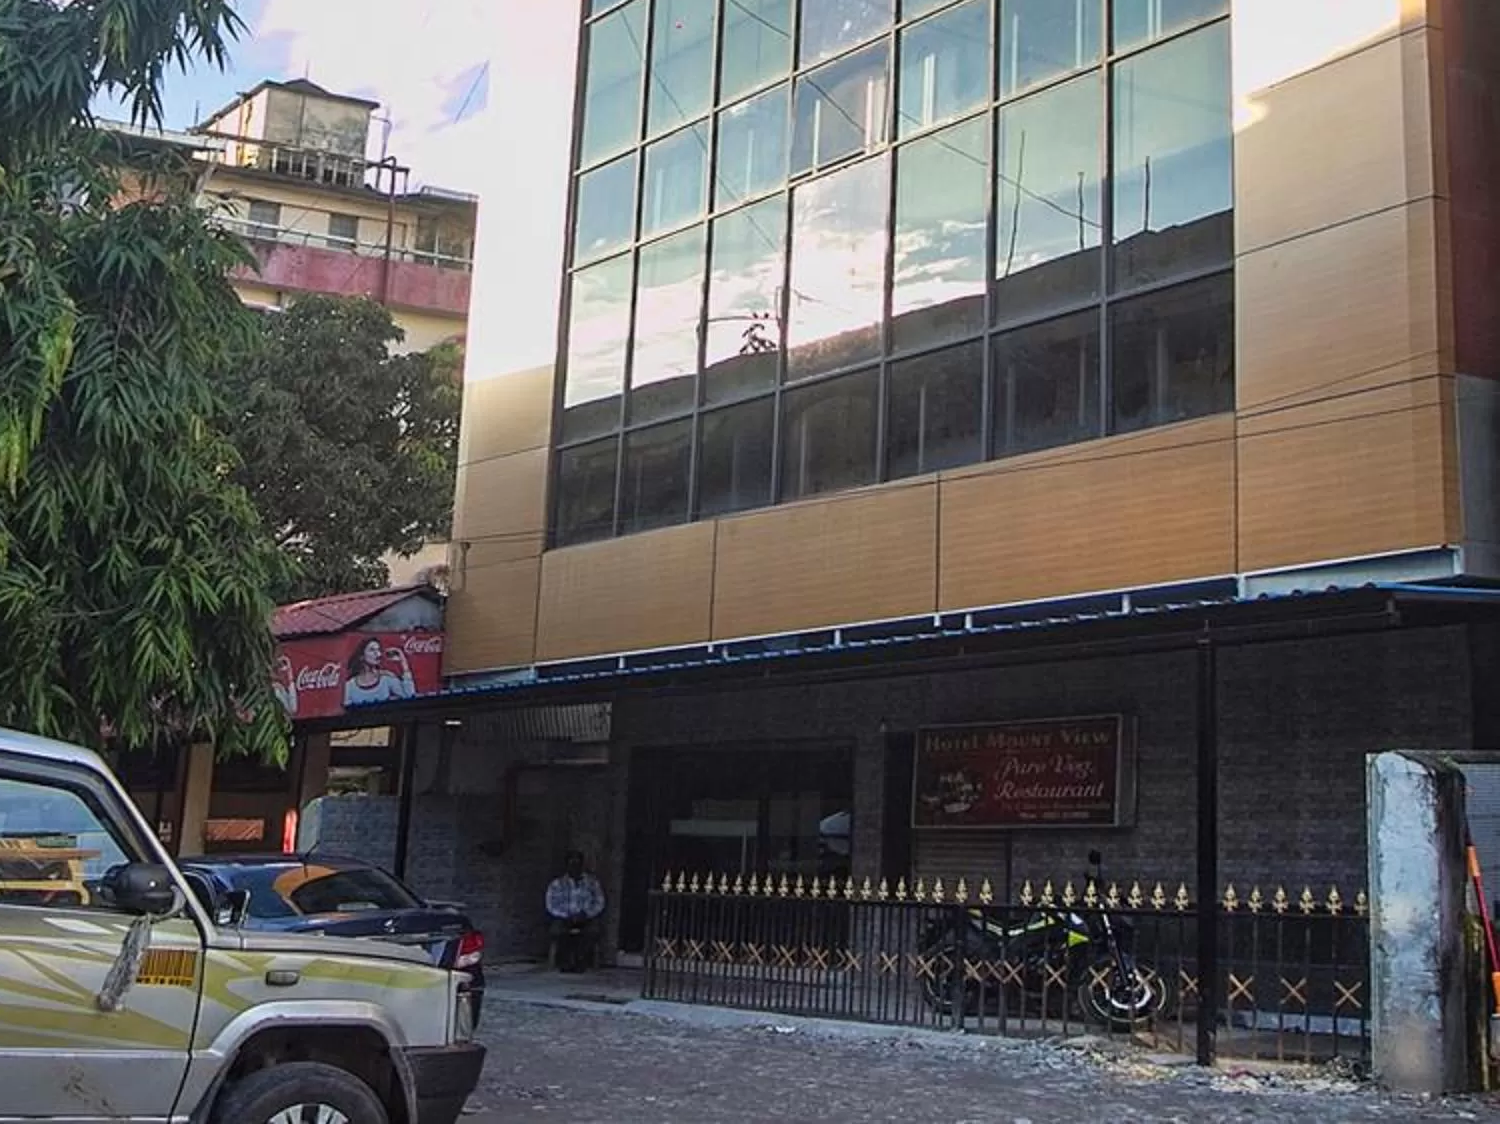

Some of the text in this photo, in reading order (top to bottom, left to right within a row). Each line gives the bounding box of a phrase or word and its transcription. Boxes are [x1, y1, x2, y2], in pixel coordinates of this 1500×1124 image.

[296, 662, 341, 691] Coca-Cola
[995, 755, 1047, 780] Pure
[994, 780, 1105, 800] Restaurant
